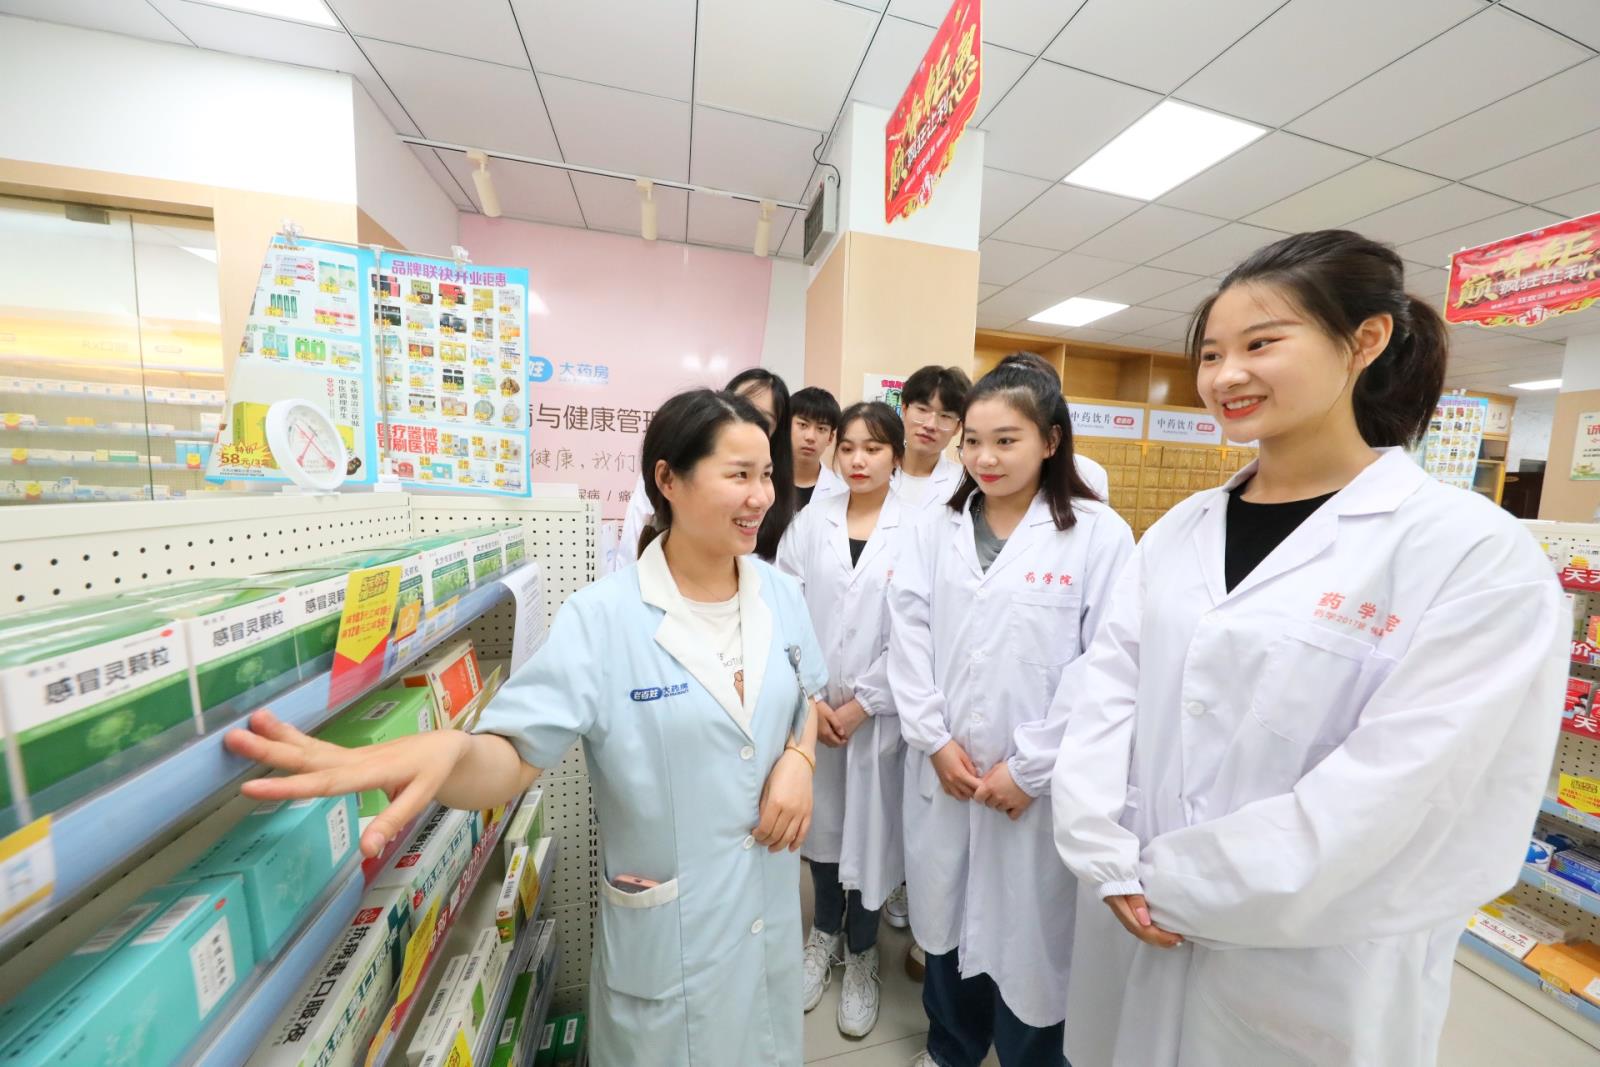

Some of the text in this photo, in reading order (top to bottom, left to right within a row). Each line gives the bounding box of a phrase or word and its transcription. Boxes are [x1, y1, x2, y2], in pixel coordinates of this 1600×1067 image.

[559, 361, 609, 378] 大药房
[1024, 571, 1073, 586] 药学院
[213, 609, 285, 648] 感冒灵颗粒
[1317, 591, 1401, 633] 药学院
[44, 646, 171, 706] 感冒灵颗粒
[283, 925, 371, 1045] 抗病毒口服液
